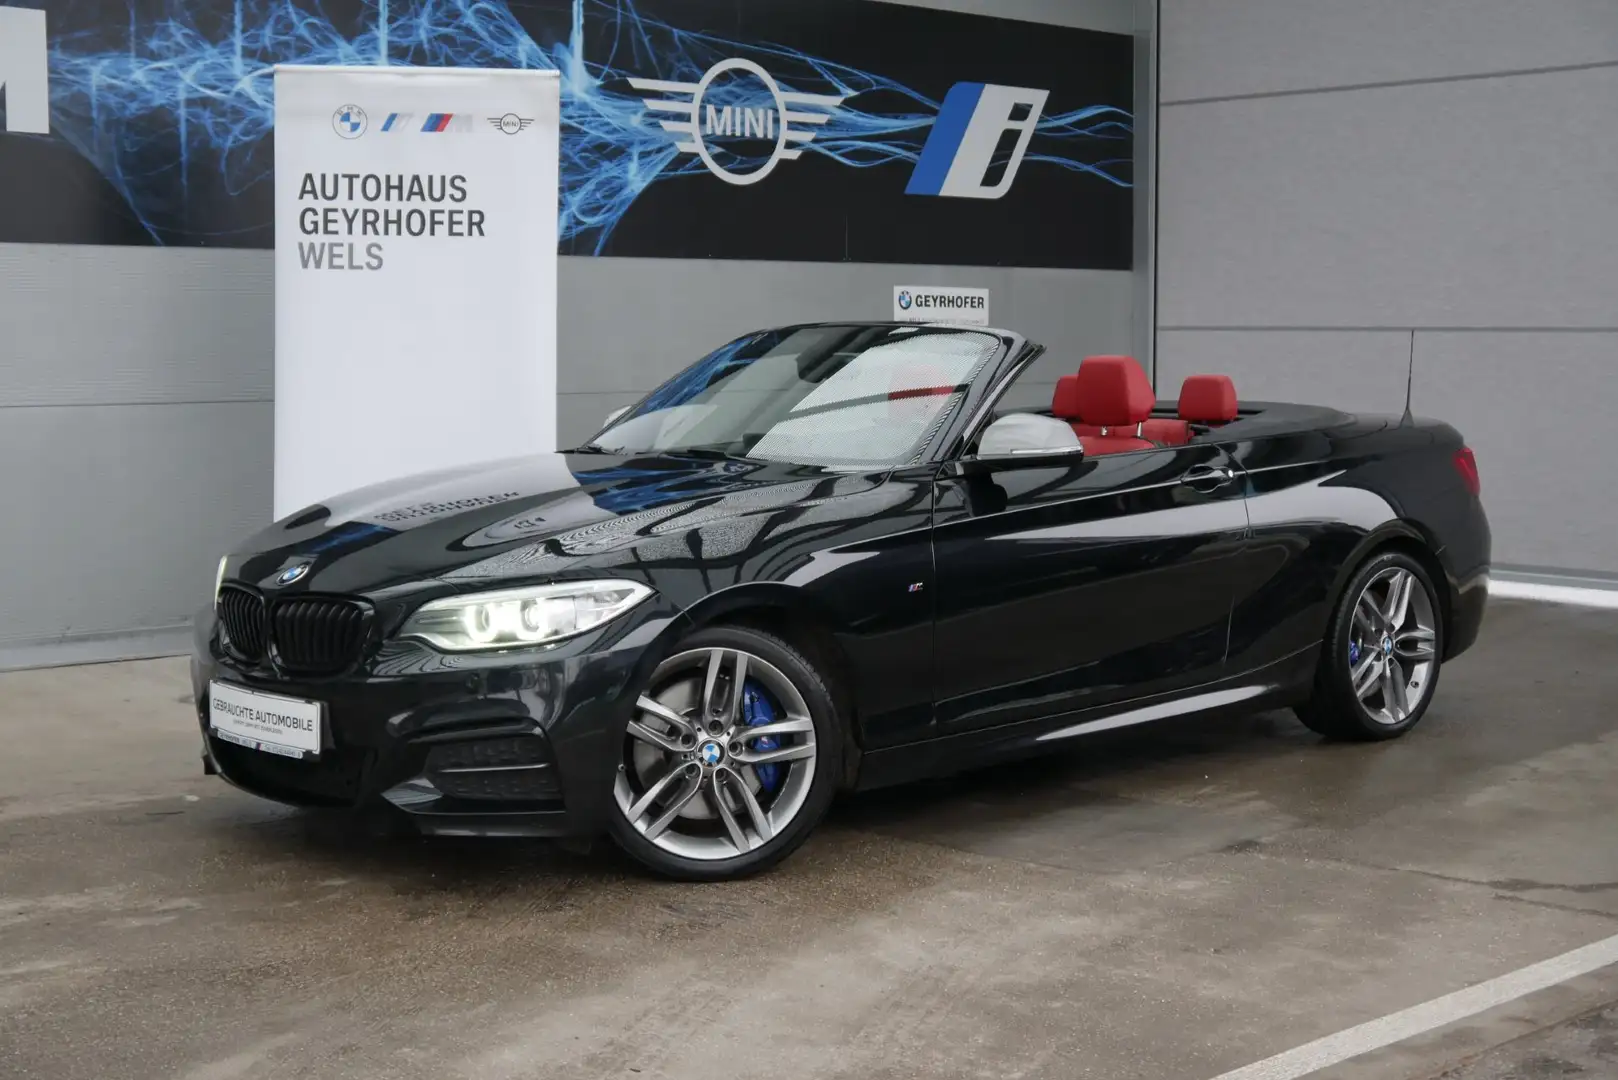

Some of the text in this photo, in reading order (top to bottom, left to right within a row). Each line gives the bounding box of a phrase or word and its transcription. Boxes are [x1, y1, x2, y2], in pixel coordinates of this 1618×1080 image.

[706, 105, 774, 139] MINI
[298, 173, 468, 202] AUTOHAUS
[299, 207, 486, 237] GEYRHOFER
[298, 242, 384, 270] WELS
[915, 294, 985, 309] GEYRHOFER
[212, 698, 254, 720] GEBRAUCHTE
[255, 710, 314, 732] AUTOMOBILE
